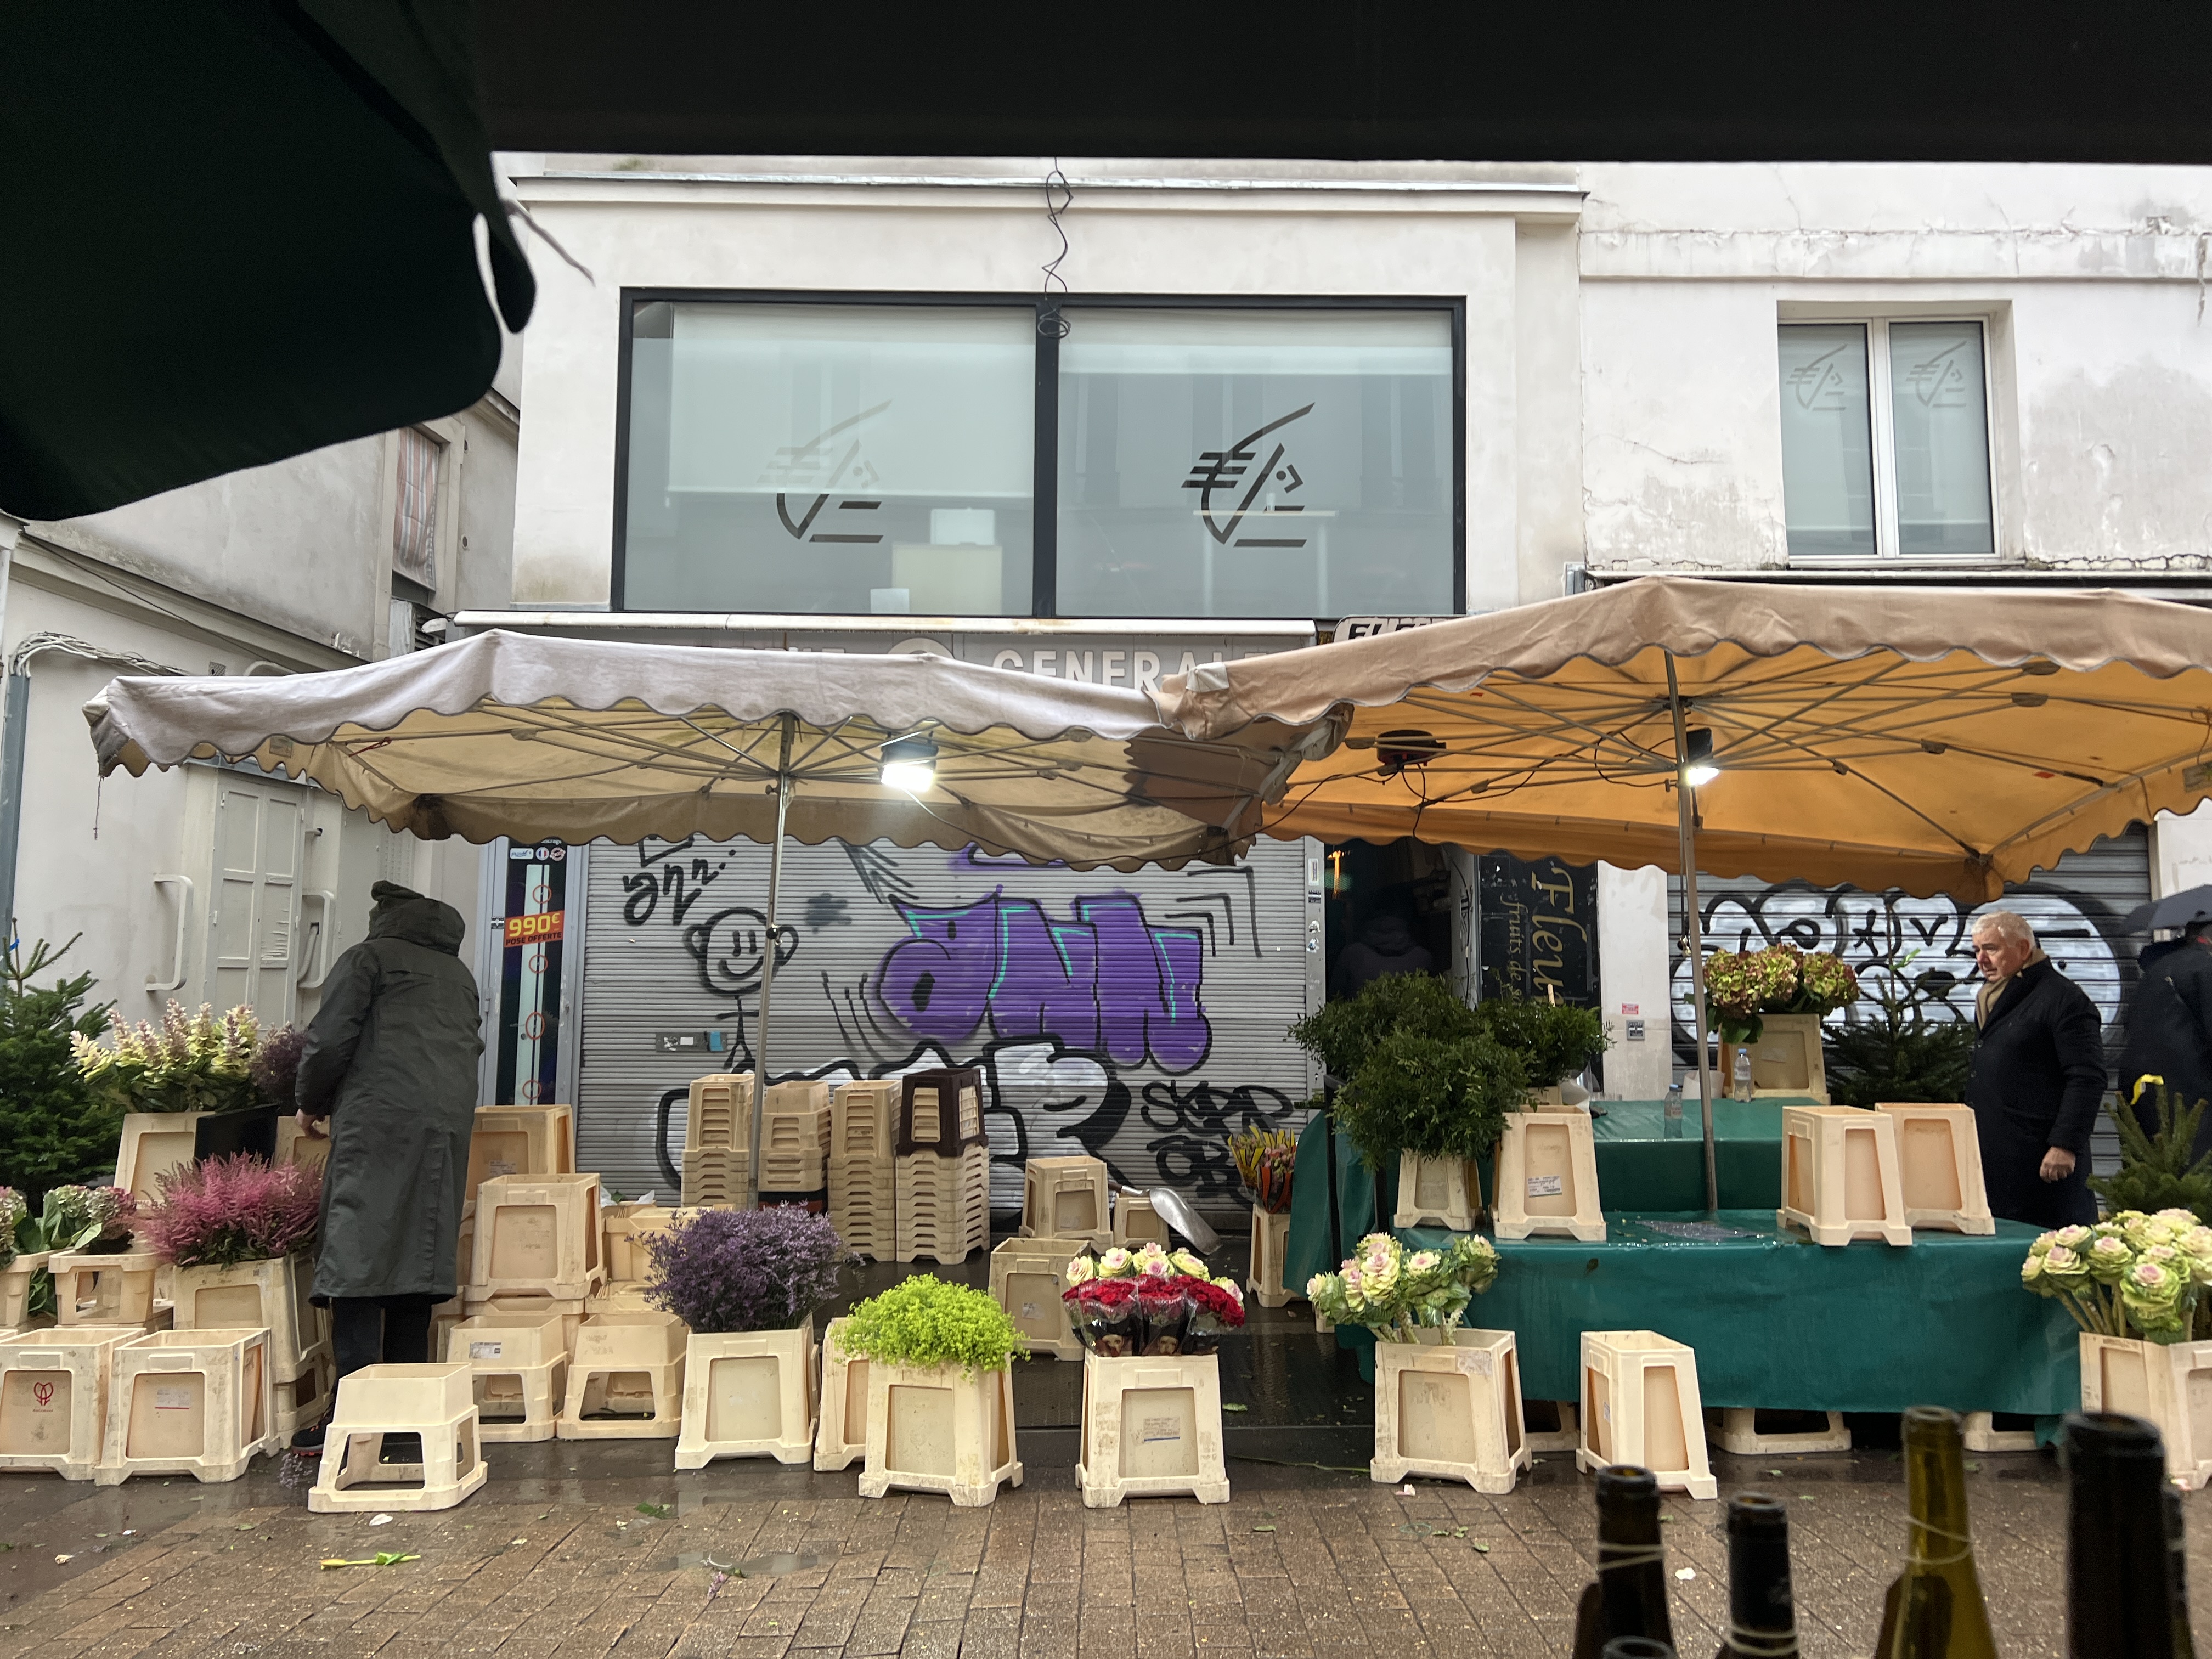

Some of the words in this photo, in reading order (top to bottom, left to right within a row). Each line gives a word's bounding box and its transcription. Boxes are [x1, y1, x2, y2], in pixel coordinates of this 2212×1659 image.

[992, 650, 1266, 691] GENERA
[509, 912, 560, 937] 990€
[505, 936, 526, 945] POSE
[528, 932, 562, 942] OFFERTE
[1509, 961, 1528, 981] de
